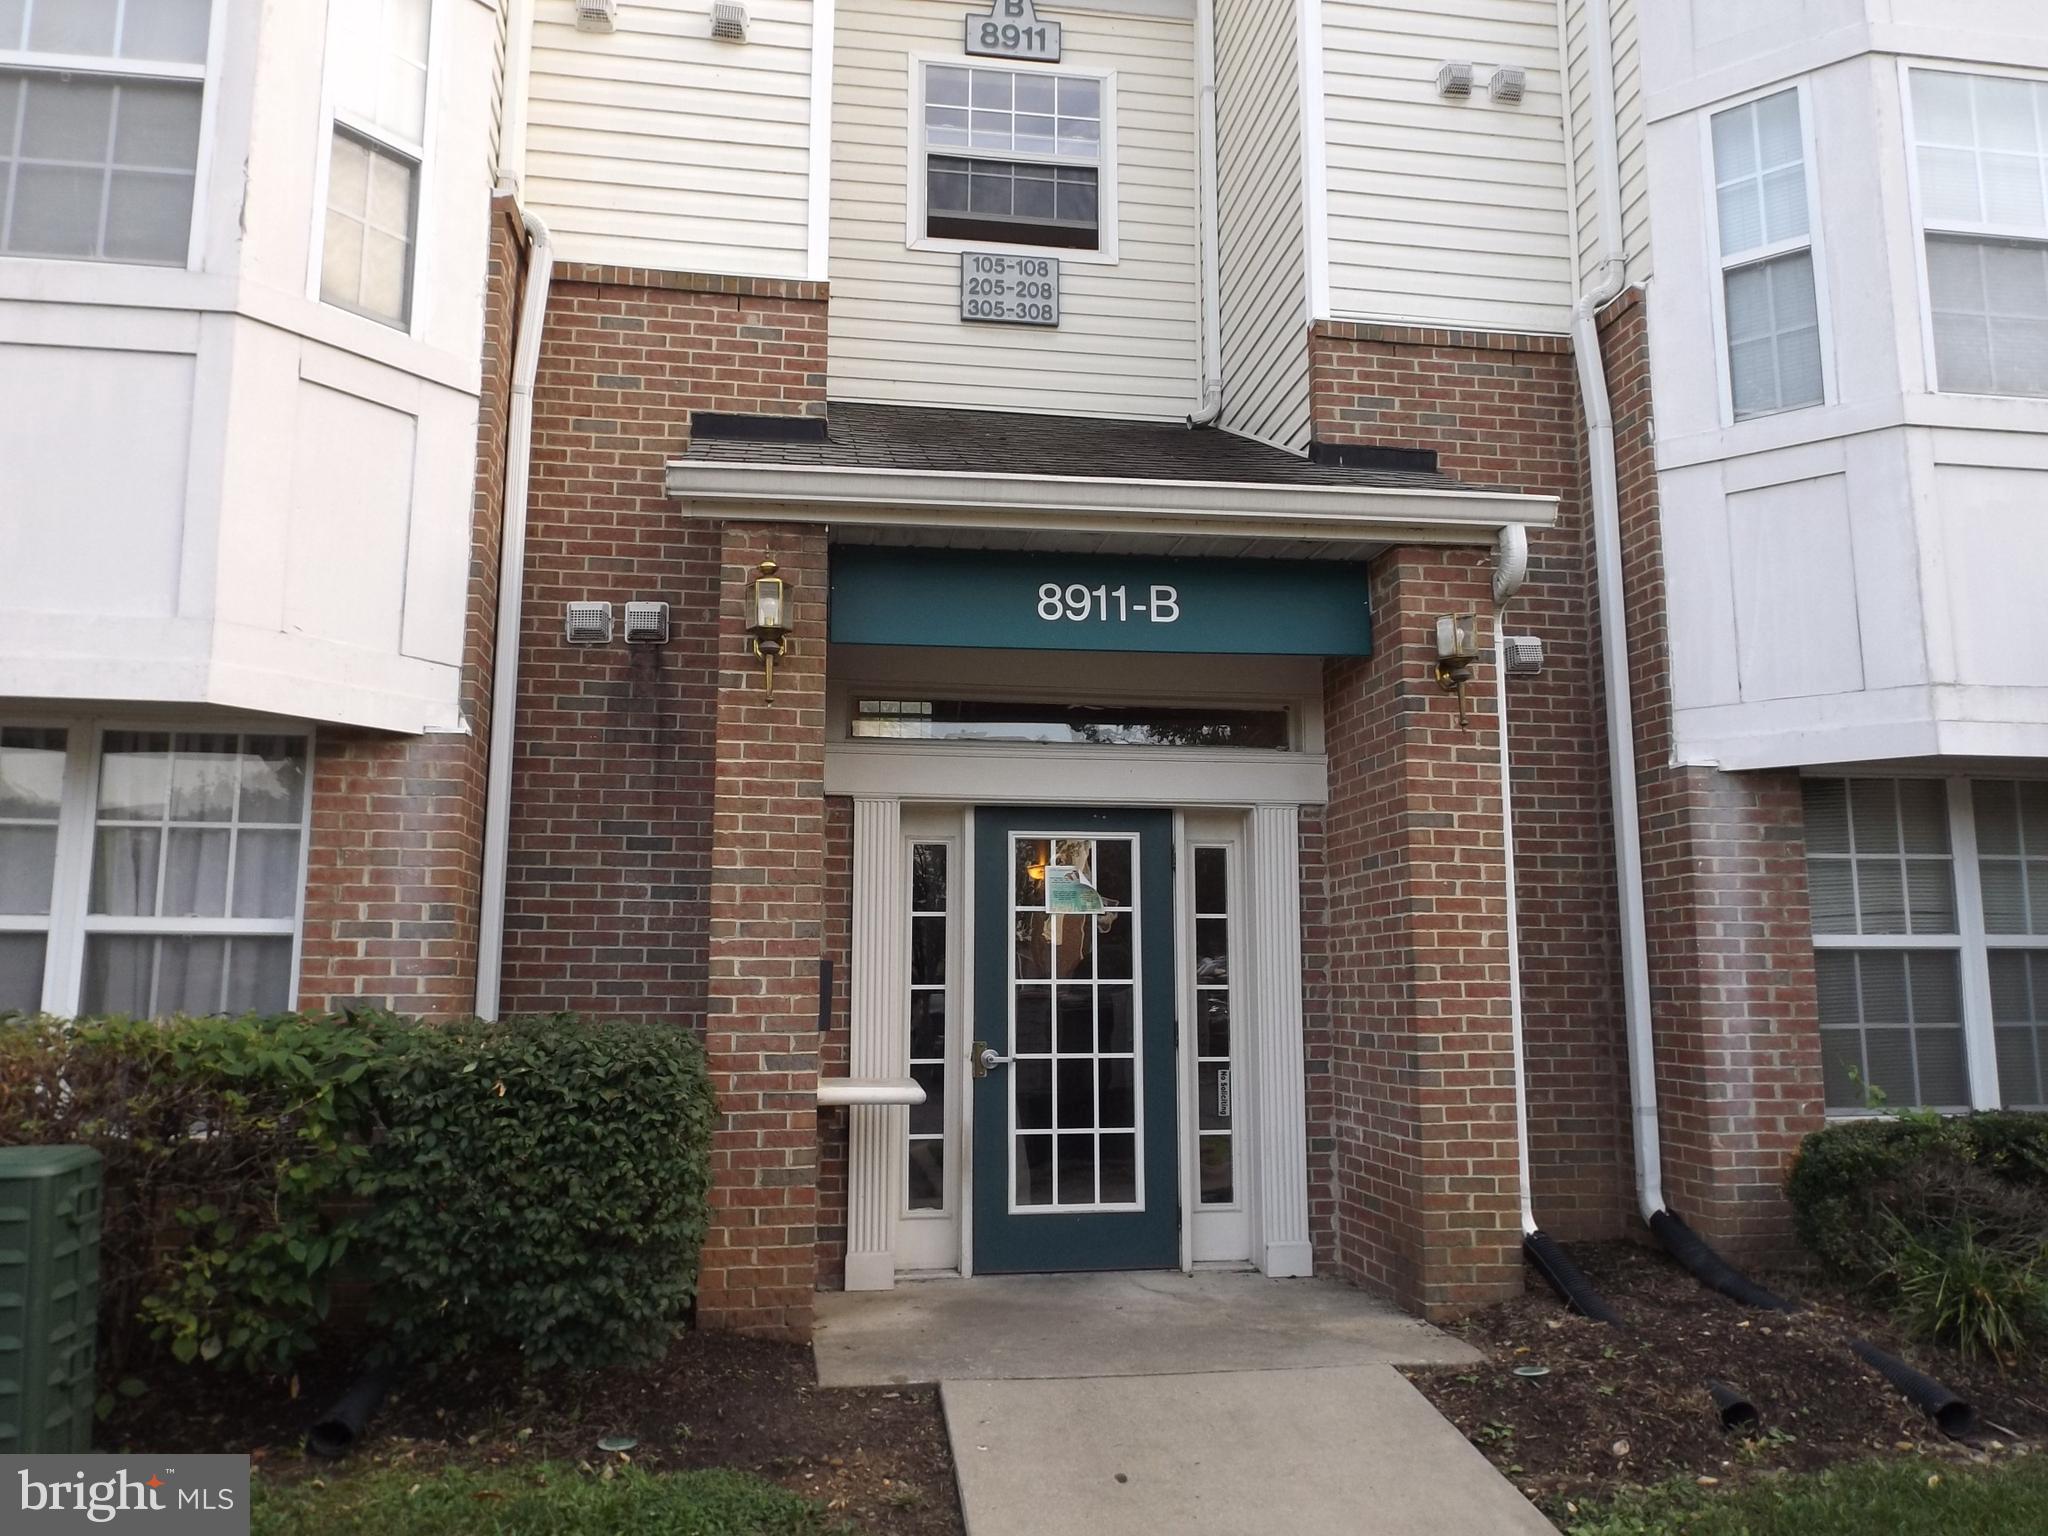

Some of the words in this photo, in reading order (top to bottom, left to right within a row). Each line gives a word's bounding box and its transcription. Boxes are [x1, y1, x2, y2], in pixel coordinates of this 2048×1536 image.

[1004, 0, 1024, 17] B
[980, 22, 1046, 51] 8911
[972, 256, 1049, 277] 105-108
[968, 277, 1052, 300] 205-208
[967, 299, 1053, 321] 305-308
[1037, 583, 1180, 622] 8911-B
[1220, 1070, 1228, 1080] No
